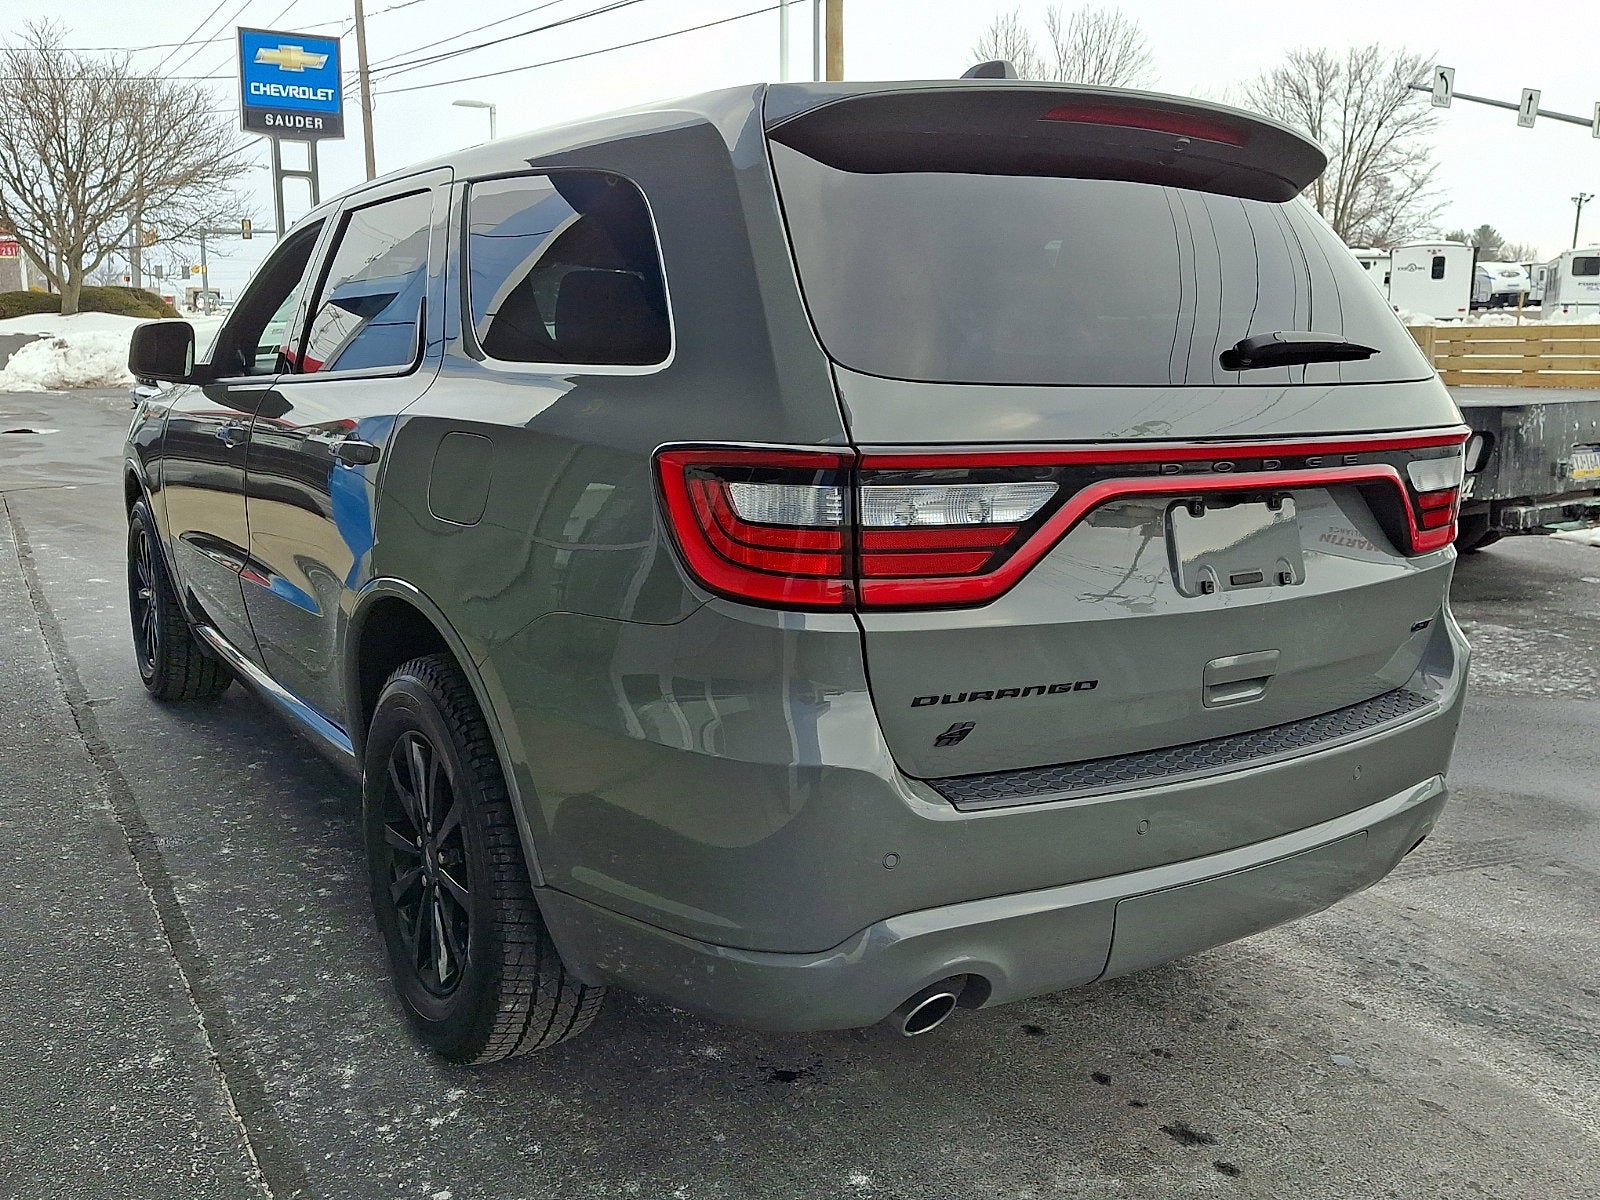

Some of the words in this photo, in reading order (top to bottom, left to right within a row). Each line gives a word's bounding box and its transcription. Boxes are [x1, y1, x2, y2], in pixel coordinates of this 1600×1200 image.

[249, 81, 335, 102] CHEVROLET
[264, 112, 324, 130] SAUDER
[1159, 453, 1360, 476] DODGE
[910, 678, 1099, 708] DURANGO
